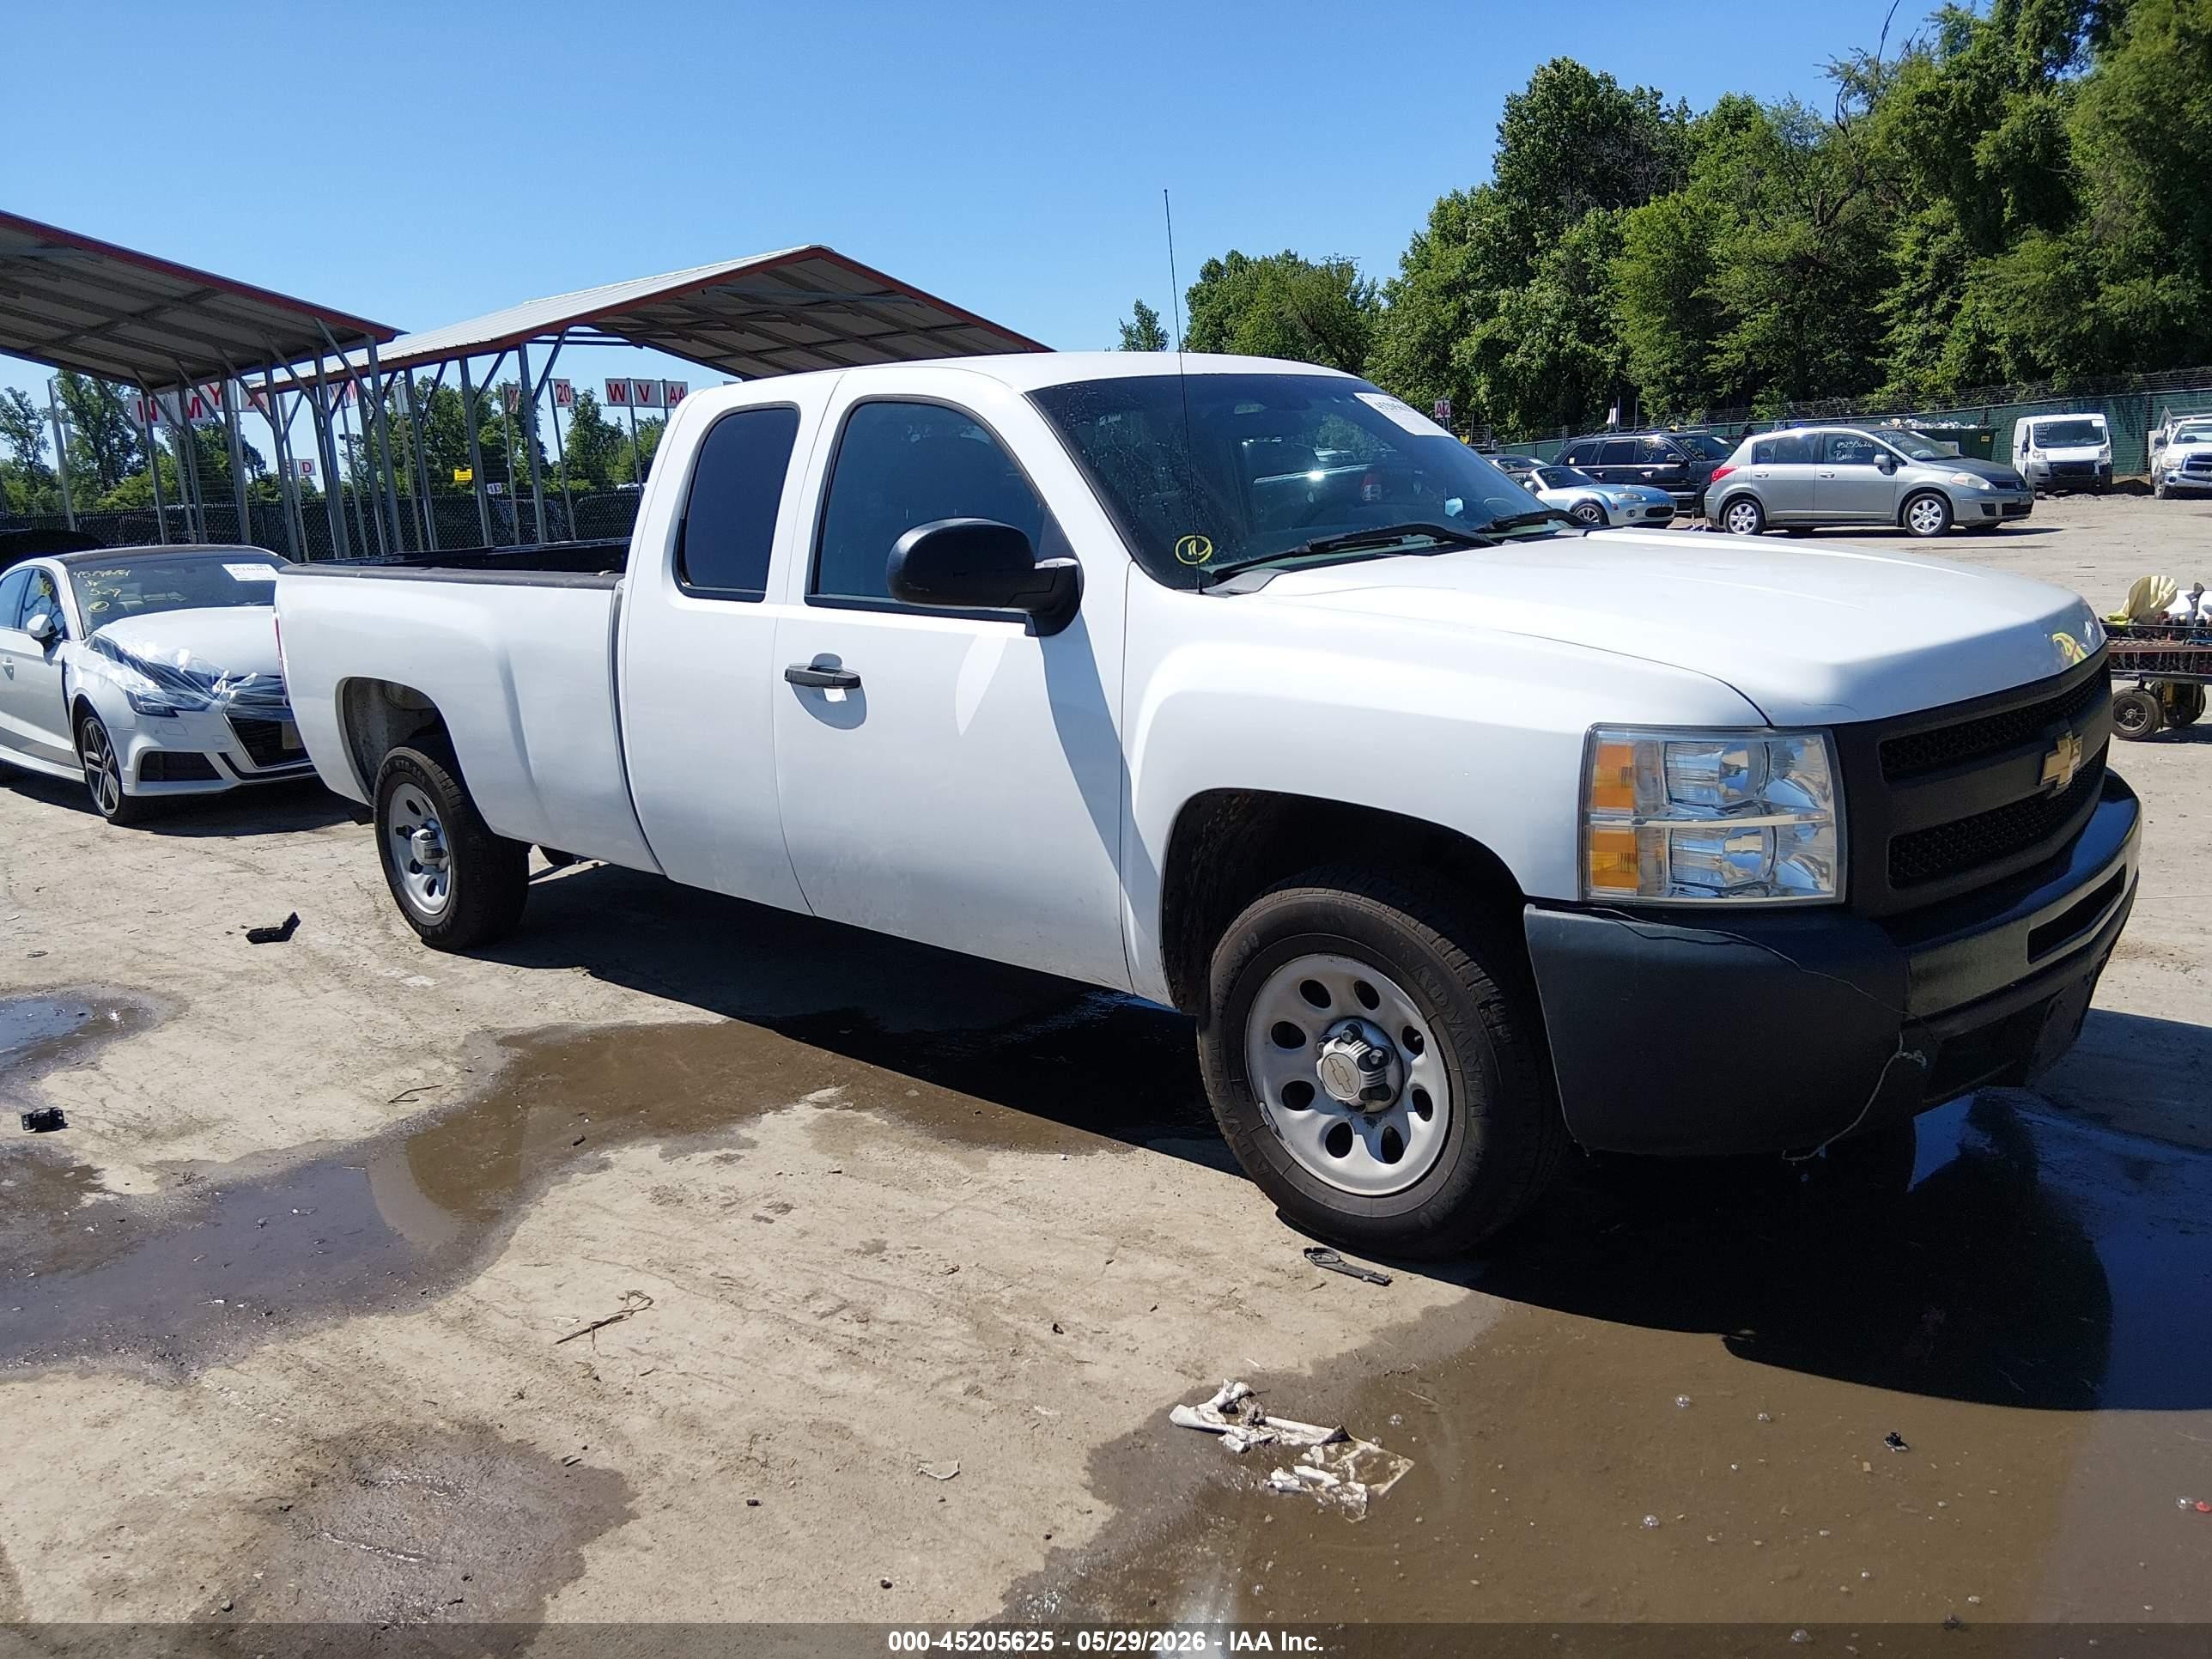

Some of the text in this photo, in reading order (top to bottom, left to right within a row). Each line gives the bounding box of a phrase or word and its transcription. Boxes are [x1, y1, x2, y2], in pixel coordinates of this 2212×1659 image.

[556, 384, 571, 403] 20
[608, 383, 650, 403] W V
[302, 462, 312, 473] D
